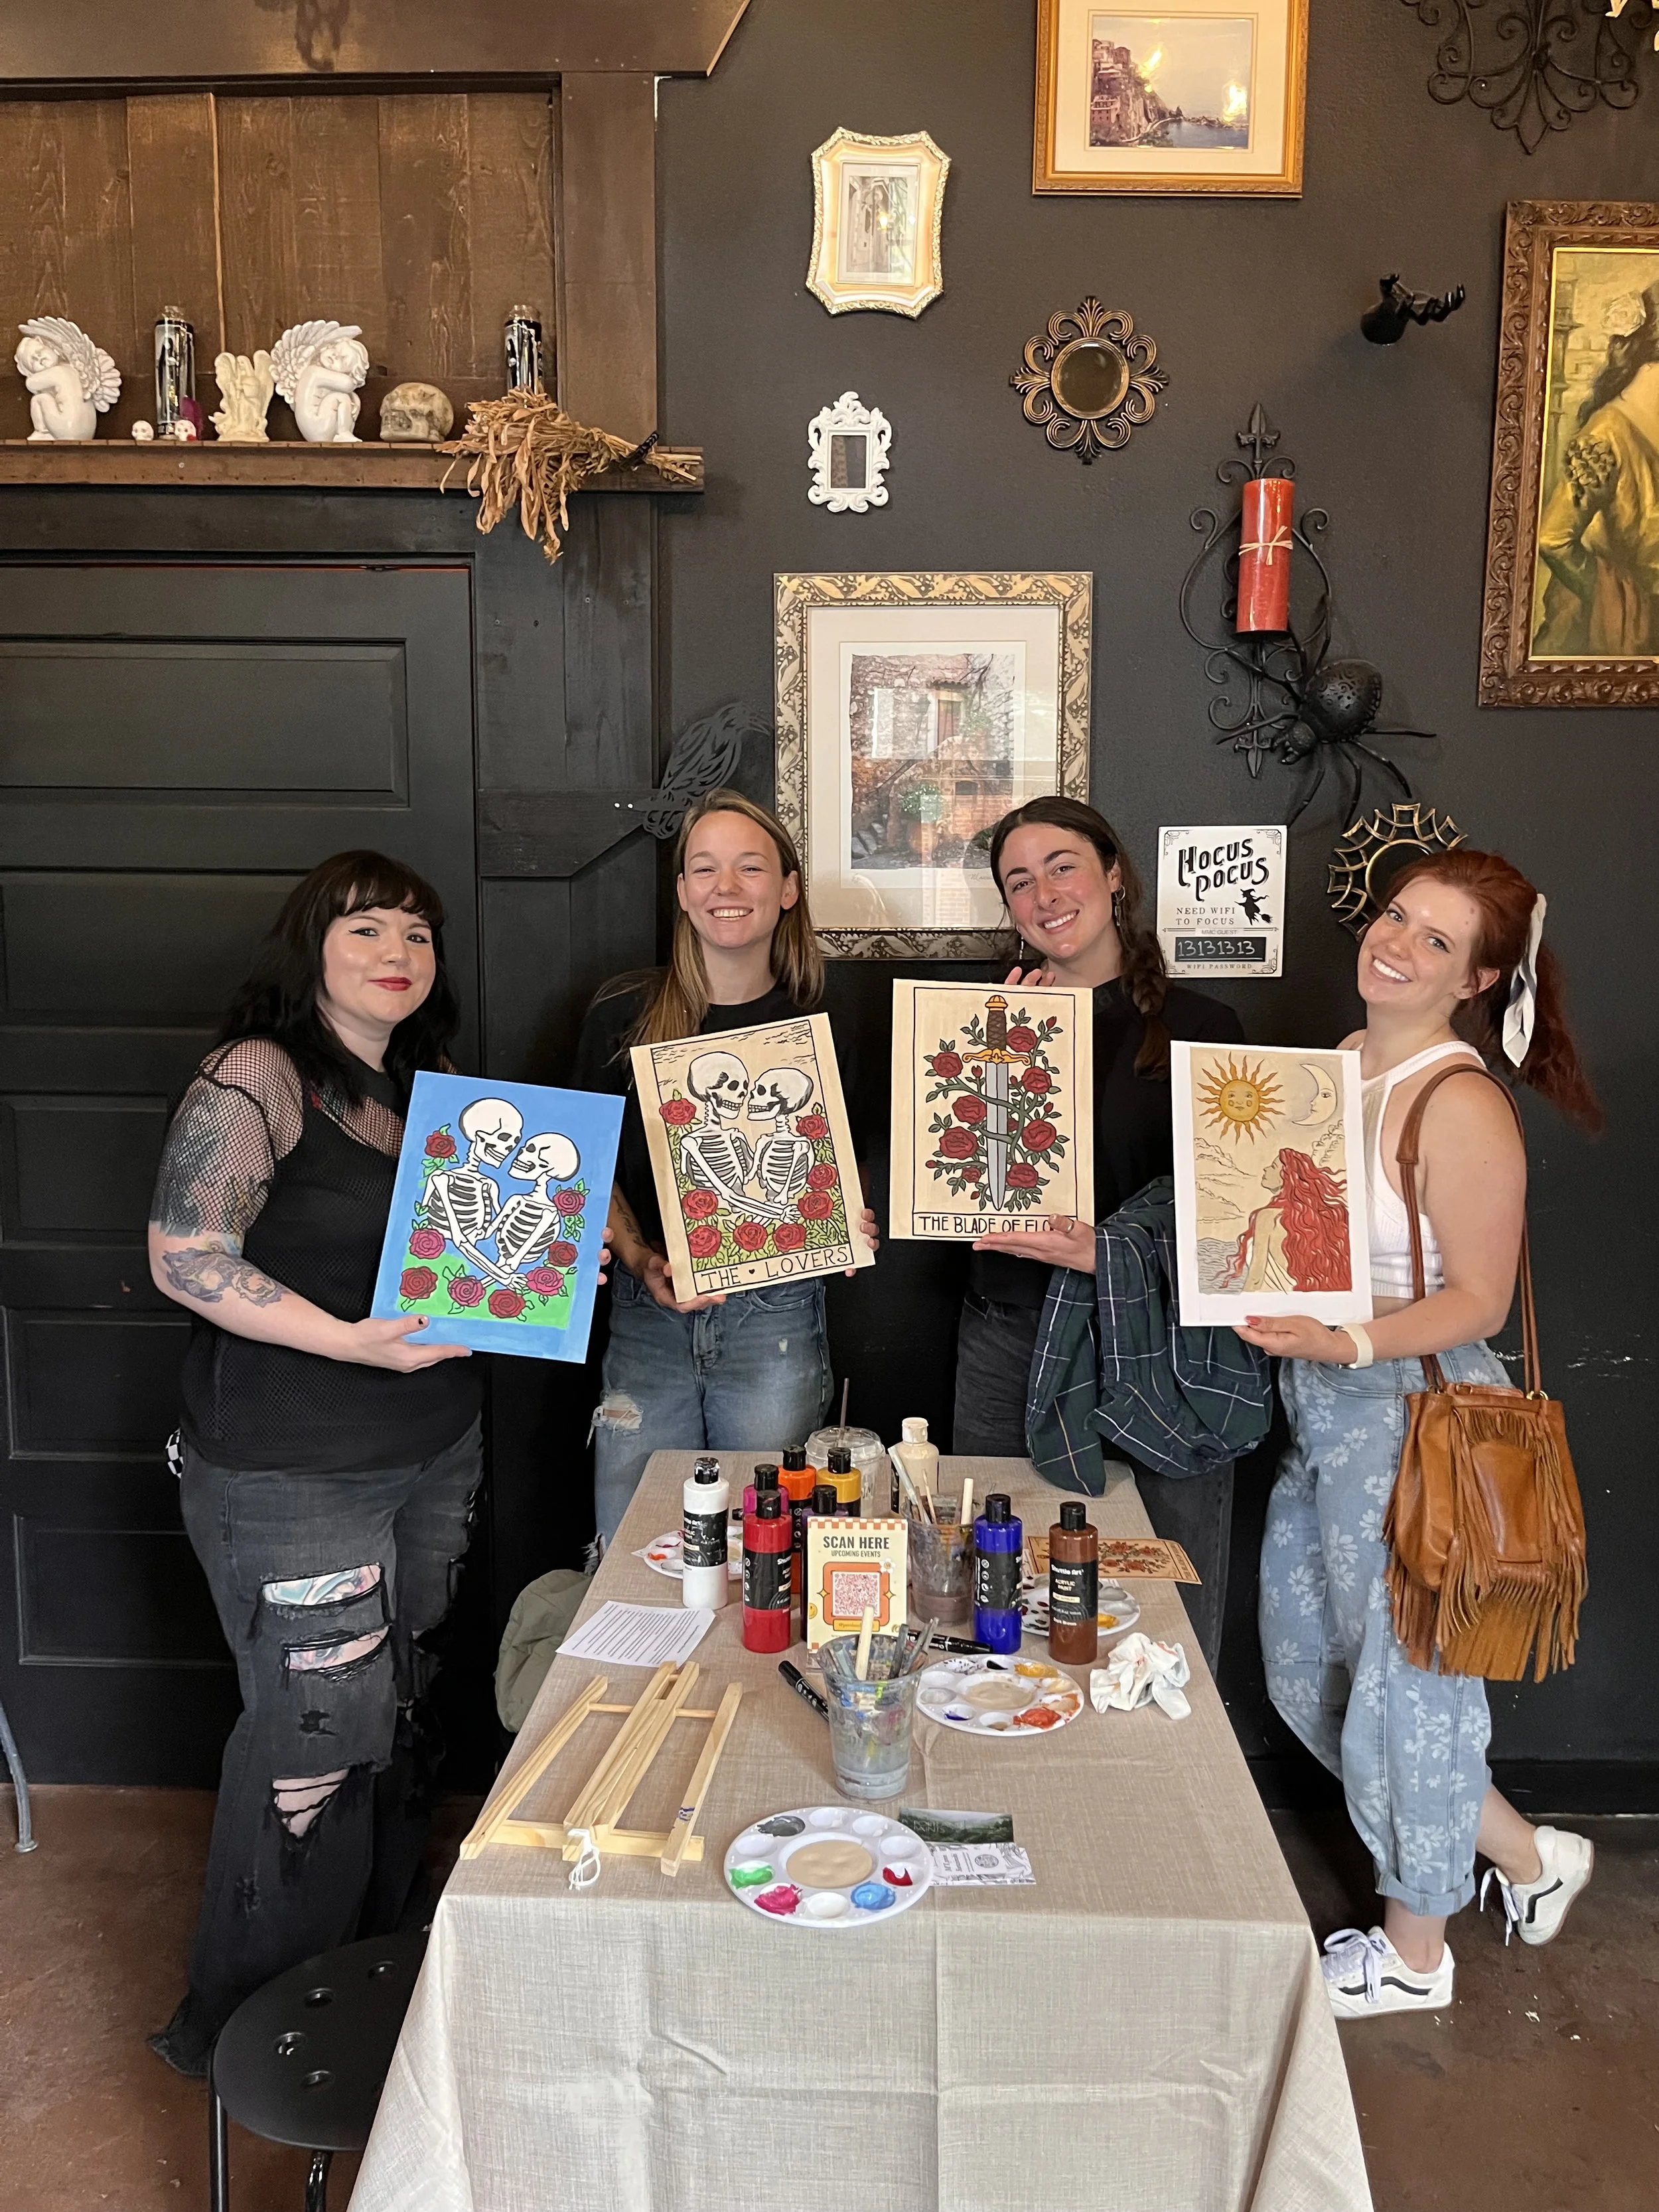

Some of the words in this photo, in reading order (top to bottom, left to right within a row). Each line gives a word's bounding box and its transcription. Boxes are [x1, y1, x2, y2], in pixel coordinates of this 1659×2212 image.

[1178, 838, 1254, 887] HOCUS
[1196, 857, 1269, 902] POCUS
[918, 1216, 948, 1231] THE
[954, 1217, 995, 1234] BLADE
[1002, 1220, 1021, 1232] OF
[701, 1266, 741, 1289] THE
[765, 1246, 848, 1278] LOVERS
[824, 1536, 855, 1549] SCAN
[859, 1536, 889, 1549] HERE
